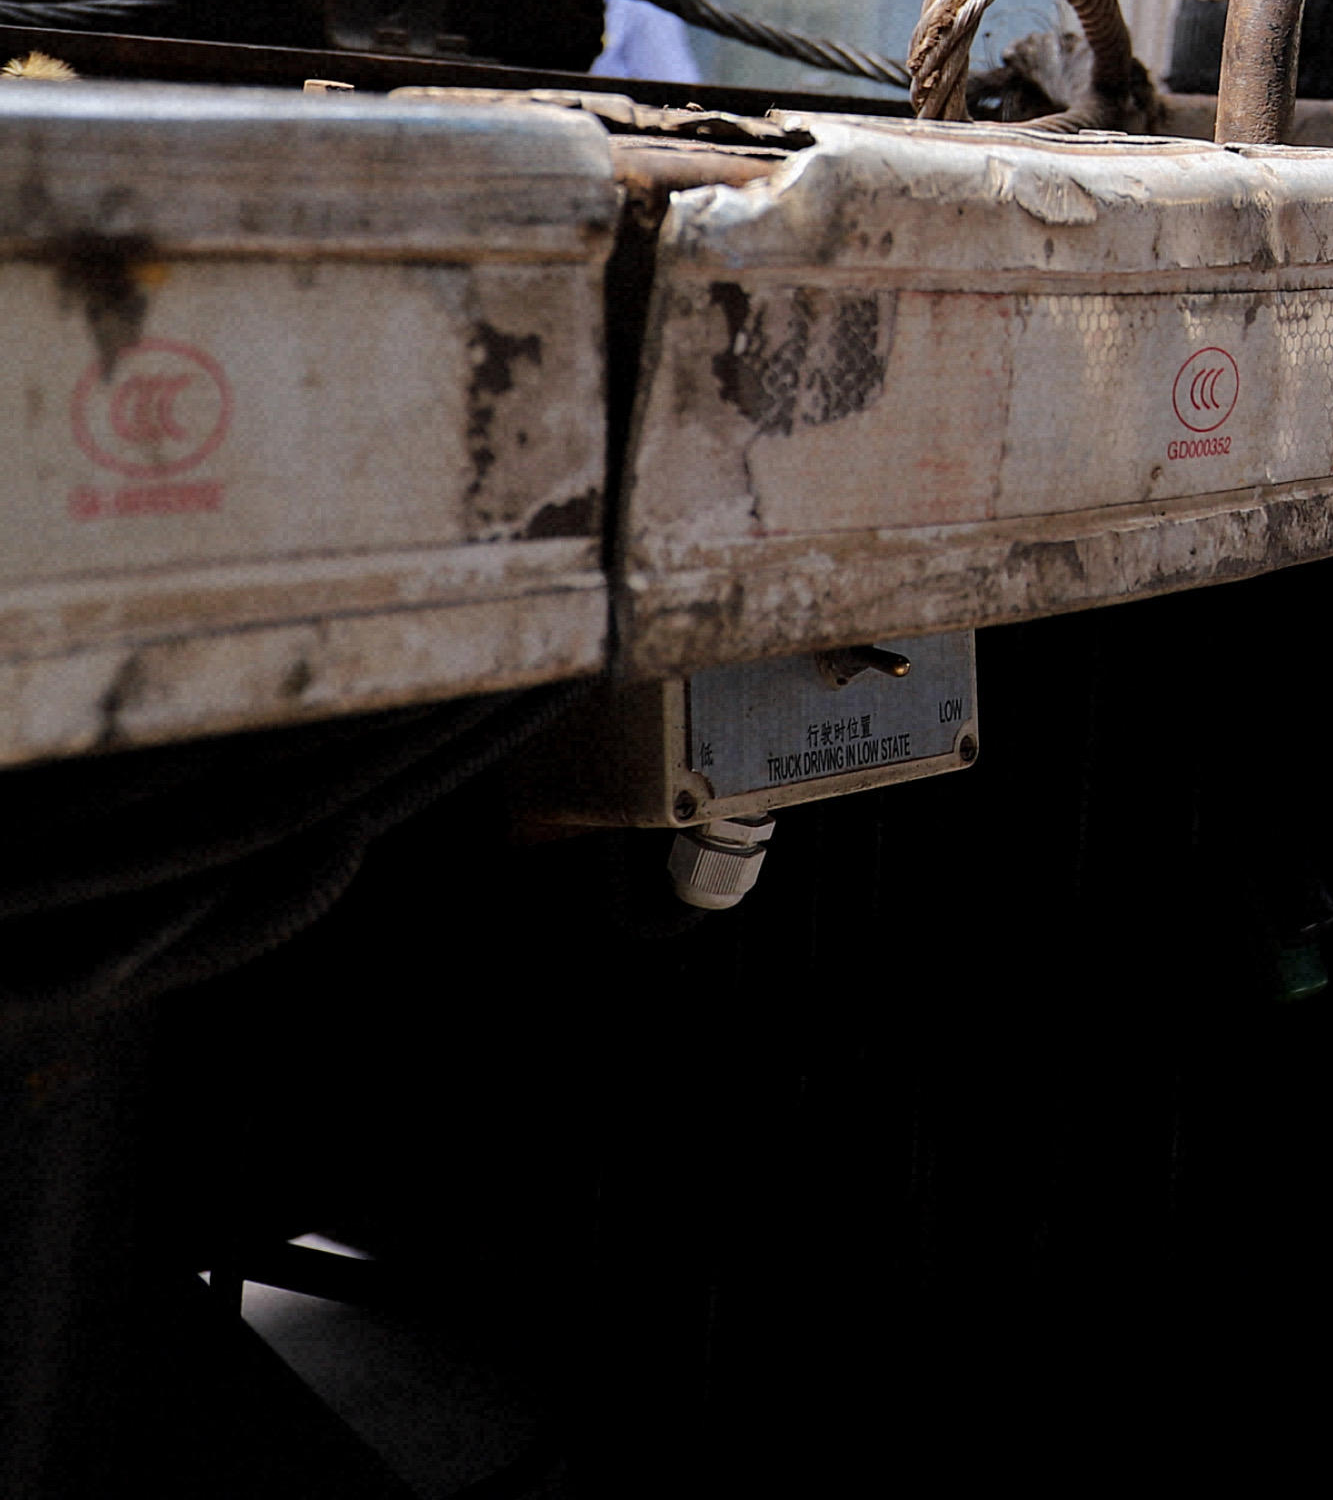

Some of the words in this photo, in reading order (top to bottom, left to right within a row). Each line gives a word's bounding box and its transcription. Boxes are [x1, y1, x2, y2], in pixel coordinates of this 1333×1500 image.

[1167, 436, 1232, 460] GD000352
[938, 698, 963, 723] LOW
[806, 714, 873, 748] 行驶时位置
[767, 753, 802, 781] TRUCK
[803, 746, 844, 775] DRIVING
[845, 742, 857, 767] IN
[857, 738, 879, 765] LOW
[880, 733, 911, 761] STATE
